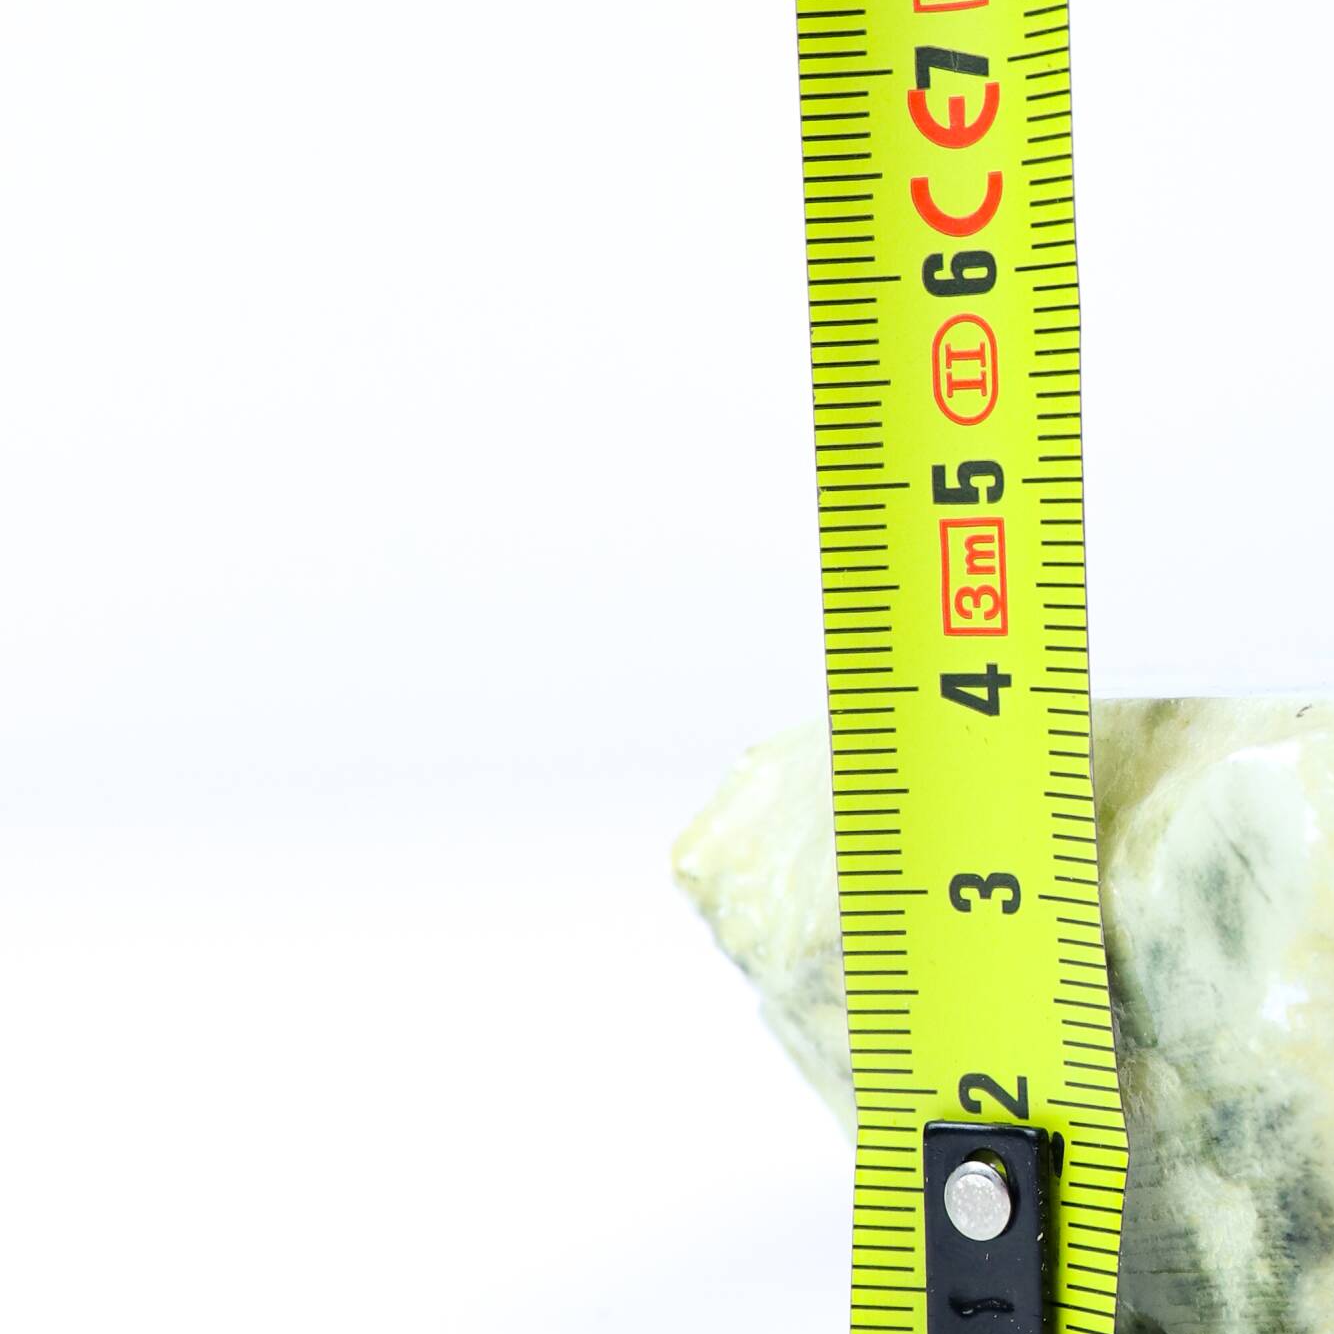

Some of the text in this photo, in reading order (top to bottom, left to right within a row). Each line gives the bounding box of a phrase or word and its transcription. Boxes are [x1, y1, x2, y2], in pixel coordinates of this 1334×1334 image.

[914, 45, 989, 95] 7
[907, 82, 1003, 237] CE
[922, 249, 998, 298] 6
[944, 340, 989, 399] II
[931, 459, 1005, 505] 5
[954, 532, 1001, 621] 3m
[940, 663, 1012, 717] 4
[949, 872, 1022, 915] 3
[958, 1072, 1031, 1120] 2
